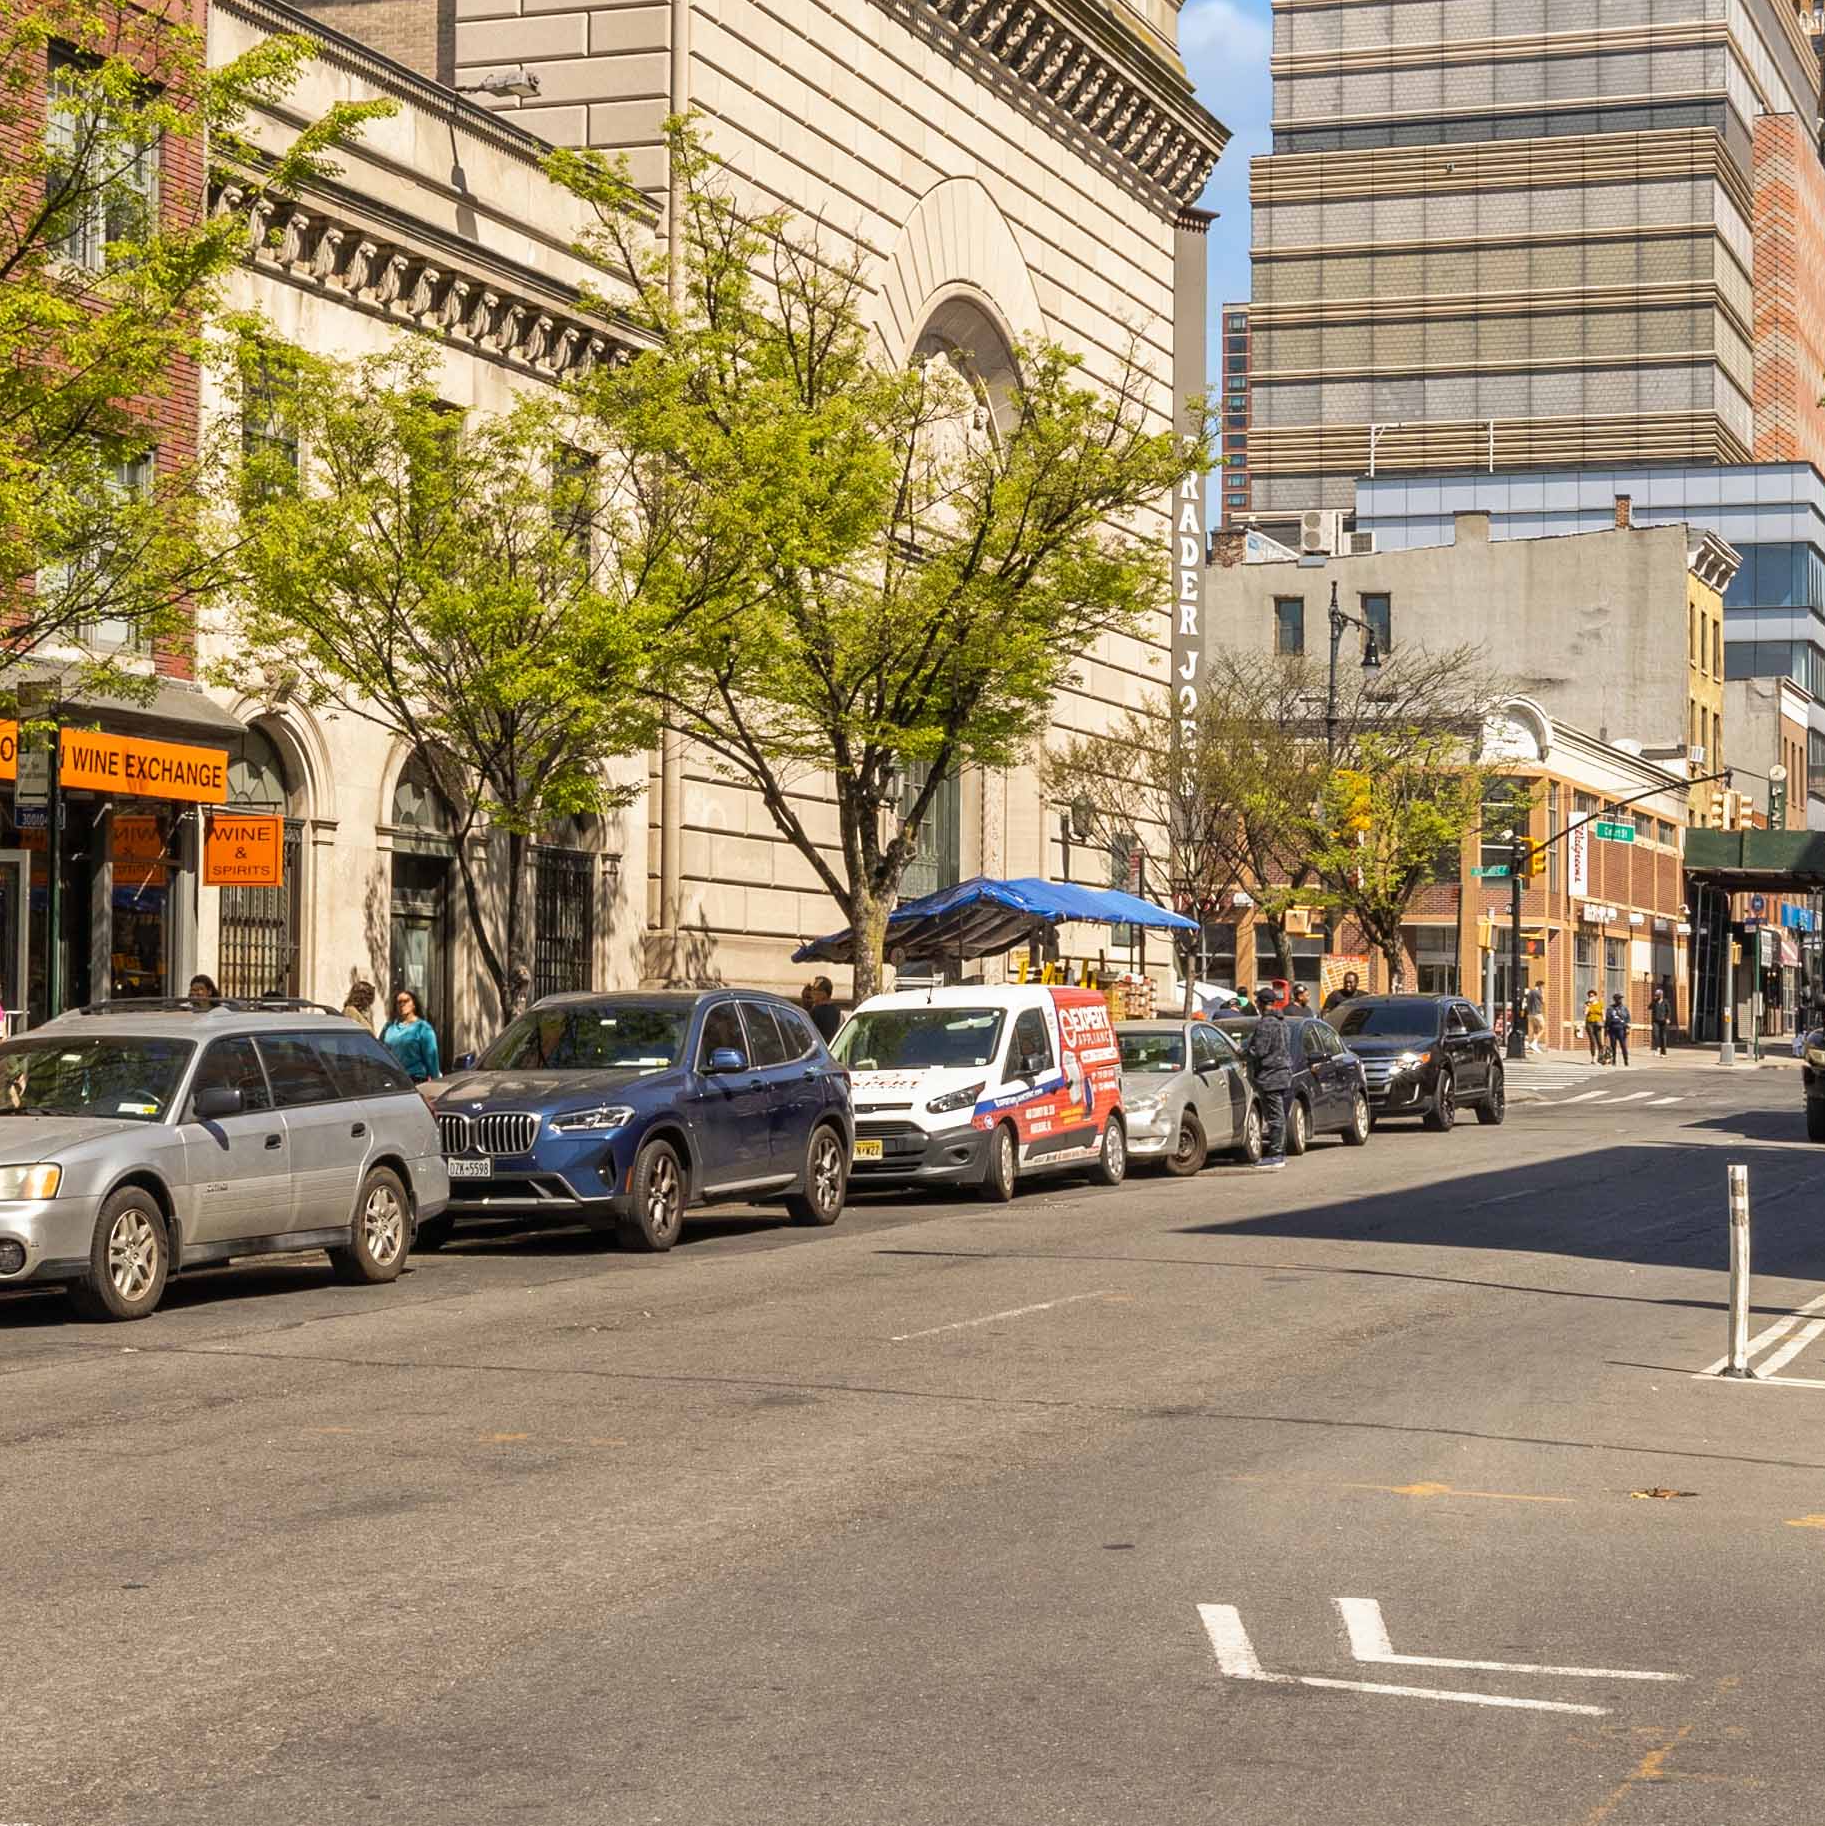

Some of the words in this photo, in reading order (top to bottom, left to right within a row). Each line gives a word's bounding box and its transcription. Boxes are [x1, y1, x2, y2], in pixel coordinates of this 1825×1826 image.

[72, 746, 119, 776] WINE
[126, 754, 223, 789] EXCHANGE
[213, 826, 271, 841] WINE
[235, 846, 247, 859] &
[212, 865, 271, 876] SPIRITS
[1068, 1005, 1110, 1032] EXPERT
